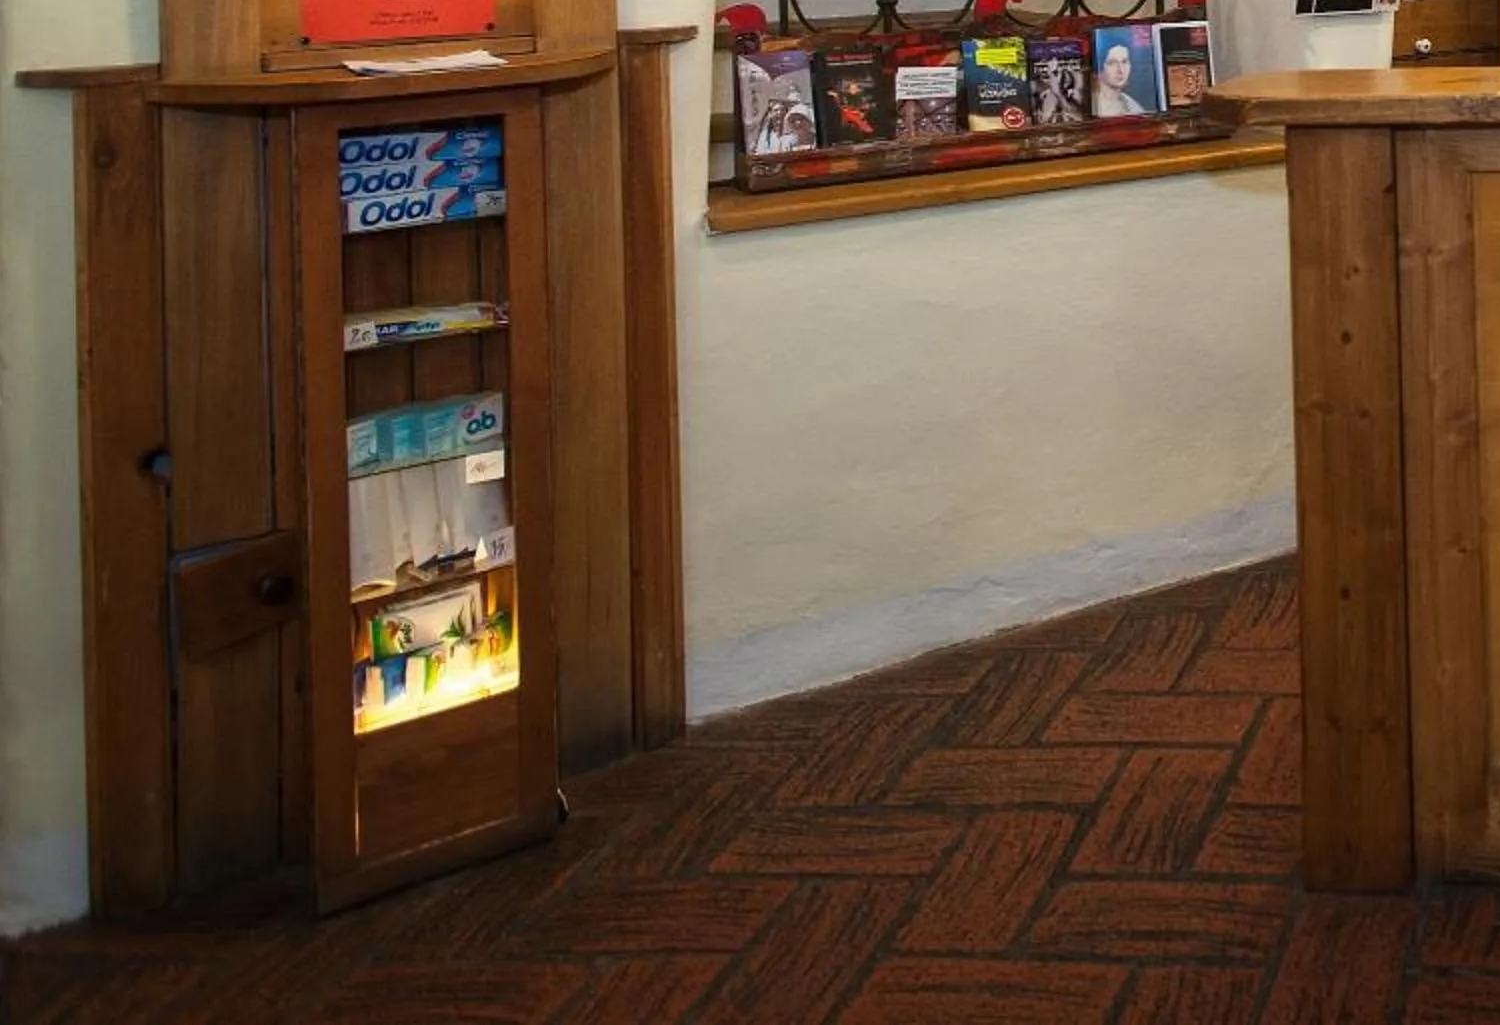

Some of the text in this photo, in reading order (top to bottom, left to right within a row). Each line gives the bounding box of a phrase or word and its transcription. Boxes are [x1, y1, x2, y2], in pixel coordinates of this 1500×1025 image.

[339, 136, 419, 164] Odol
[339, 165, 417, 196] Odol
[360, 193, 435, 226] Odol
